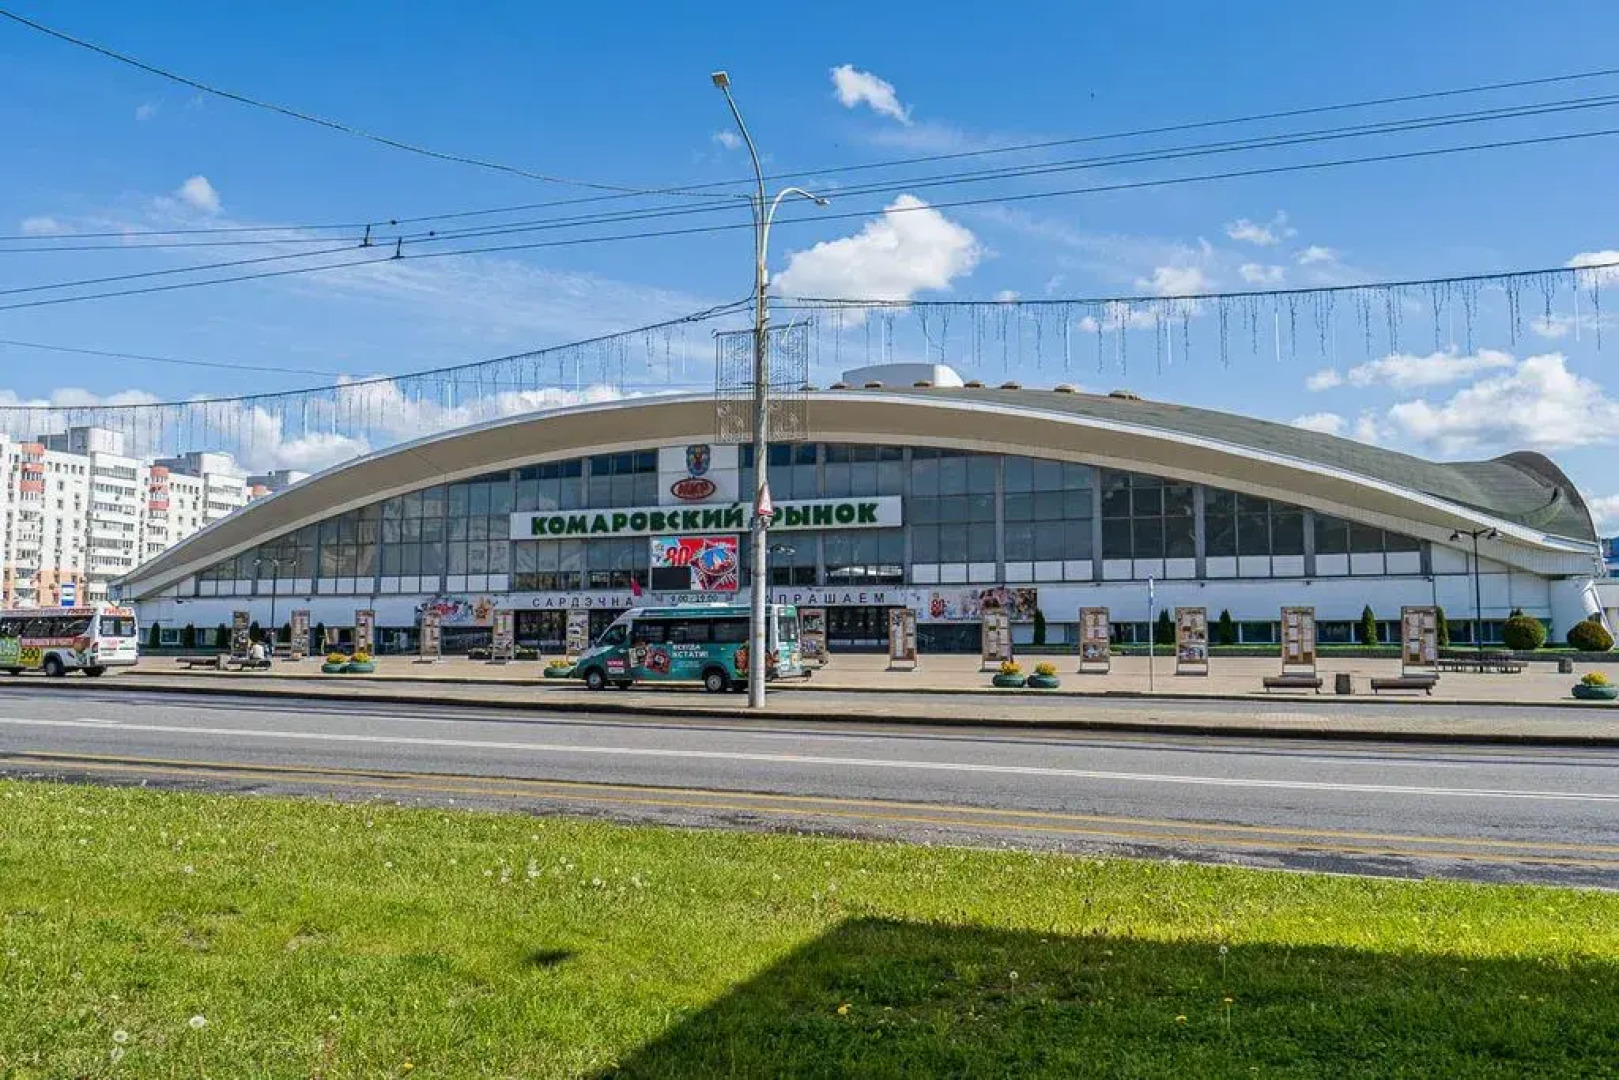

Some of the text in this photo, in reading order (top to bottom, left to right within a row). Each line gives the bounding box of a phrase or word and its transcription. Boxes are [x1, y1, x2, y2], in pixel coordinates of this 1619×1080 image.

[531, 502, 880, 535] КОМАРОВСКИЙ РЫНОК
[532, 592, 885, 608] САРДЭЧНА АПРАШАЕМ
